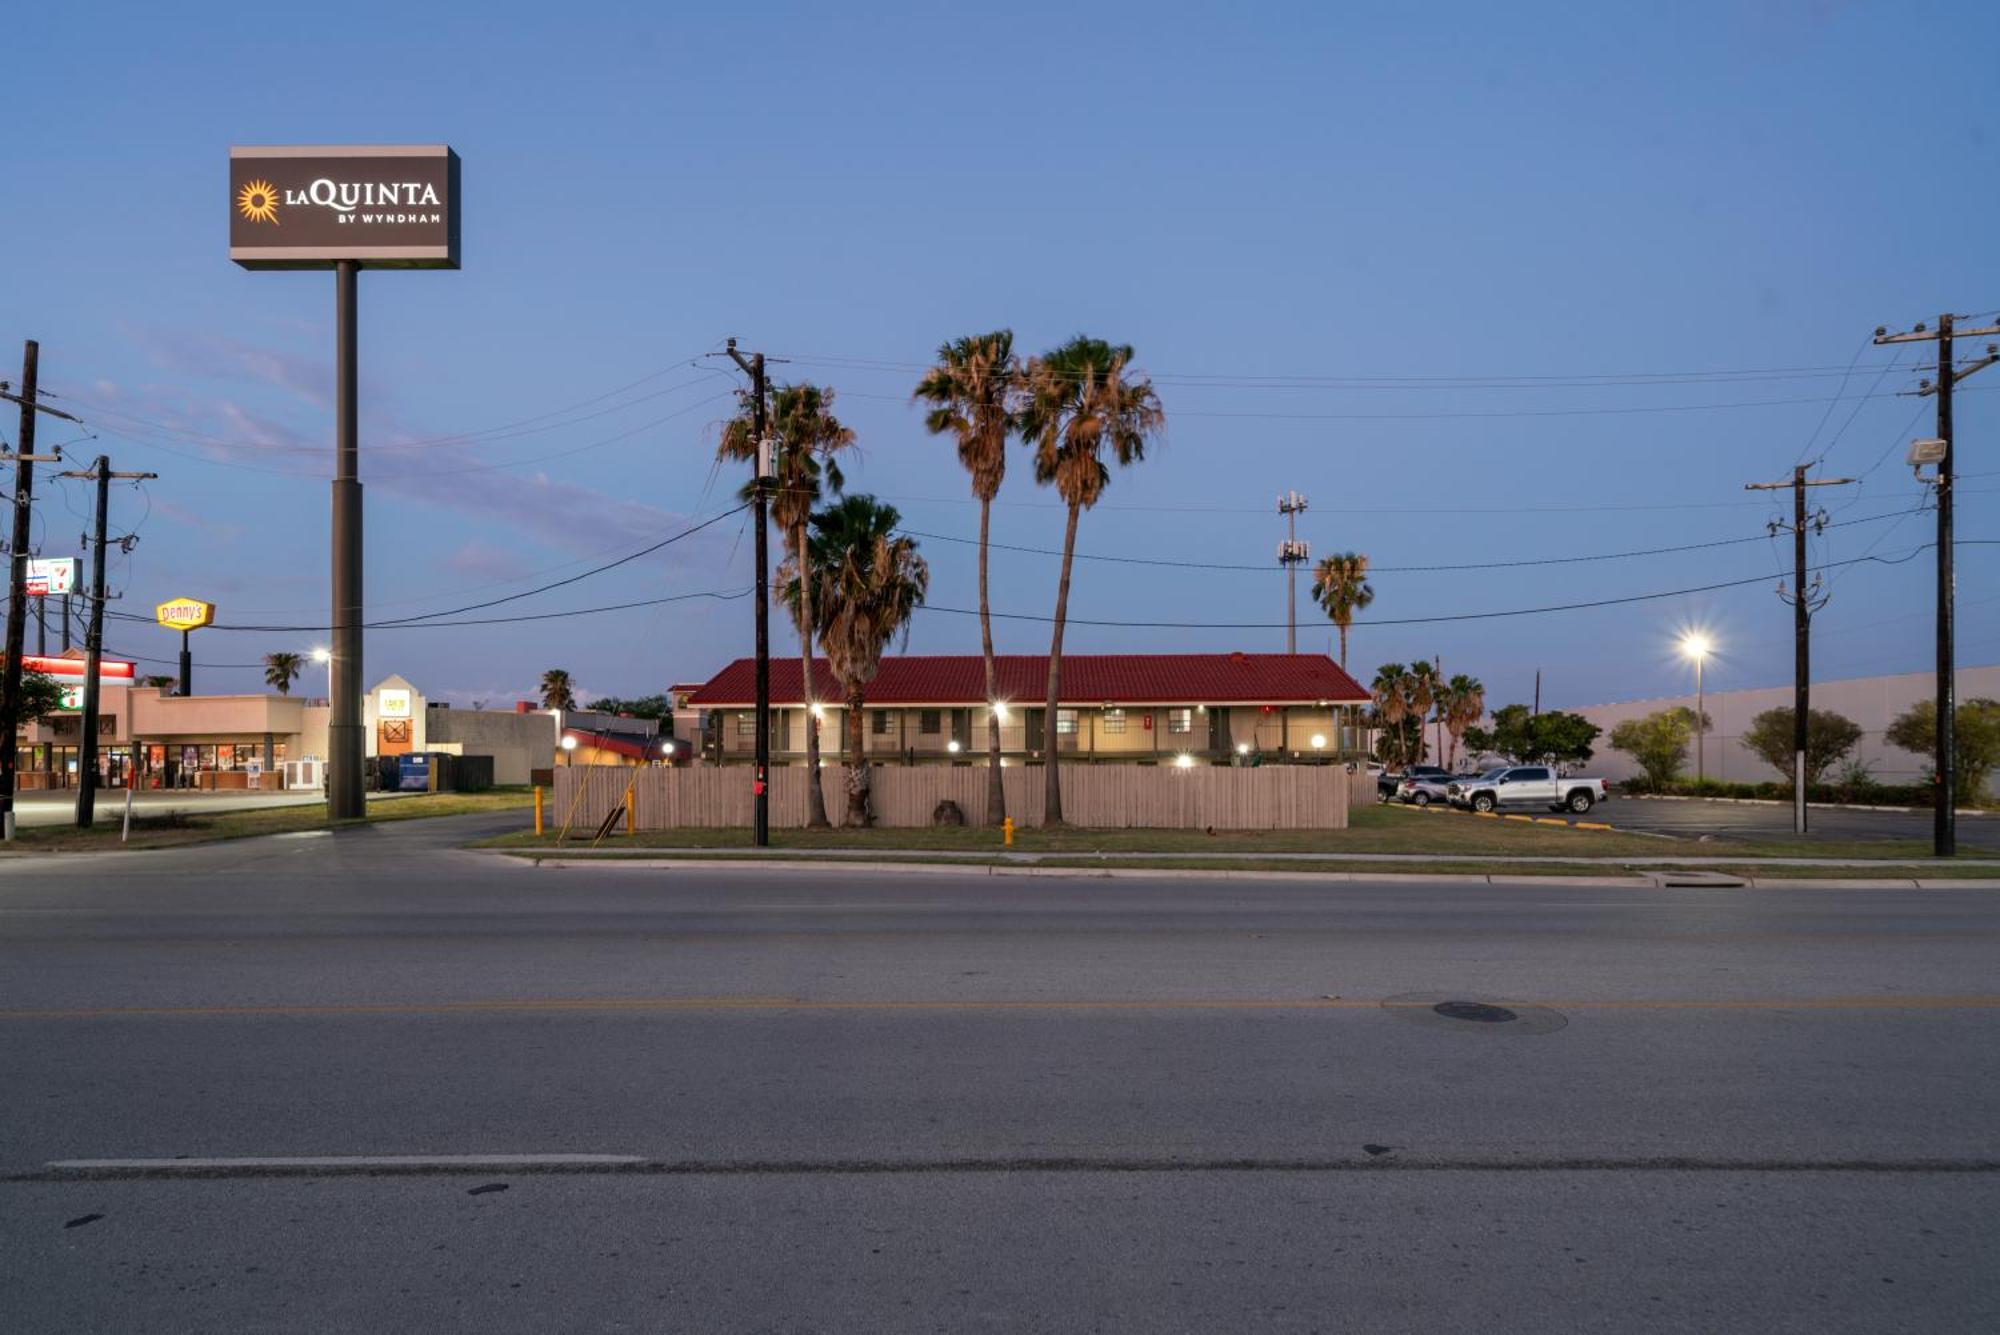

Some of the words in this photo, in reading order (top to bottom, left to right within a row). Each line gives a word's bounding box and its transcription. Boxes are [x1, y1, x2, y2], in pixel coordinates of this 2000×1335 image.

[338, 213, 356, 223] BY
[363, 213, 441, 223] WYNDHAM
[162, 604, 202, 623] Denny's
